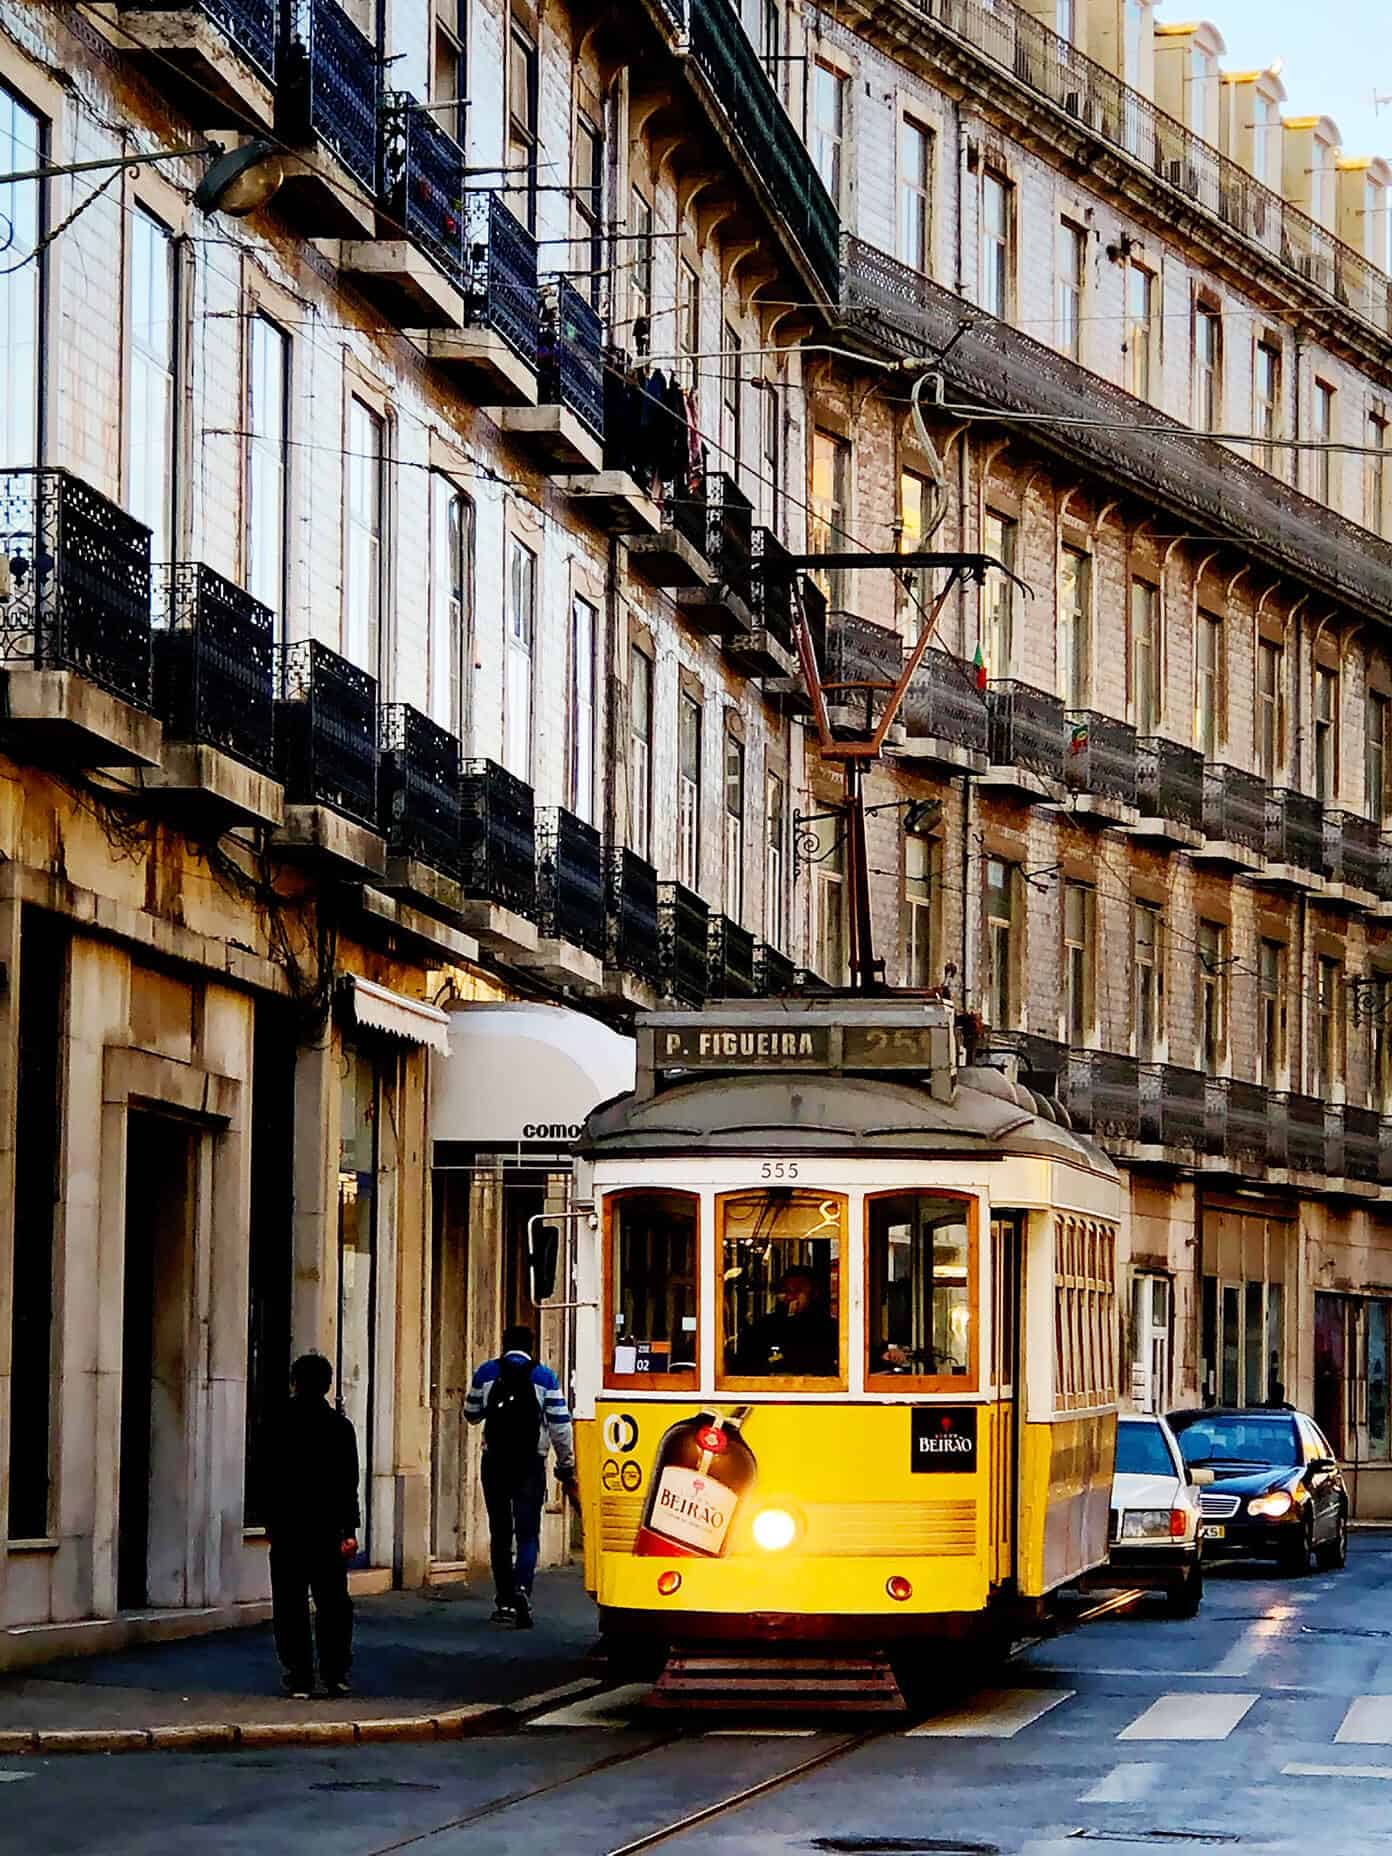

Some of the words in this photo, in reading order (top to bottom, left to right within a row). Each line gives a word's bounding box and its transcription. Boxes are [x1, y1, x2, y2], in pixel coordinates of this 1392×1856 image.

[666, 1032, 689, 1056] P.
[699, 1032, 814, 1057] FIGUEIRA
[760, 1162, 800, 1180] 555
[636, 1359, 650, 1372] 02
